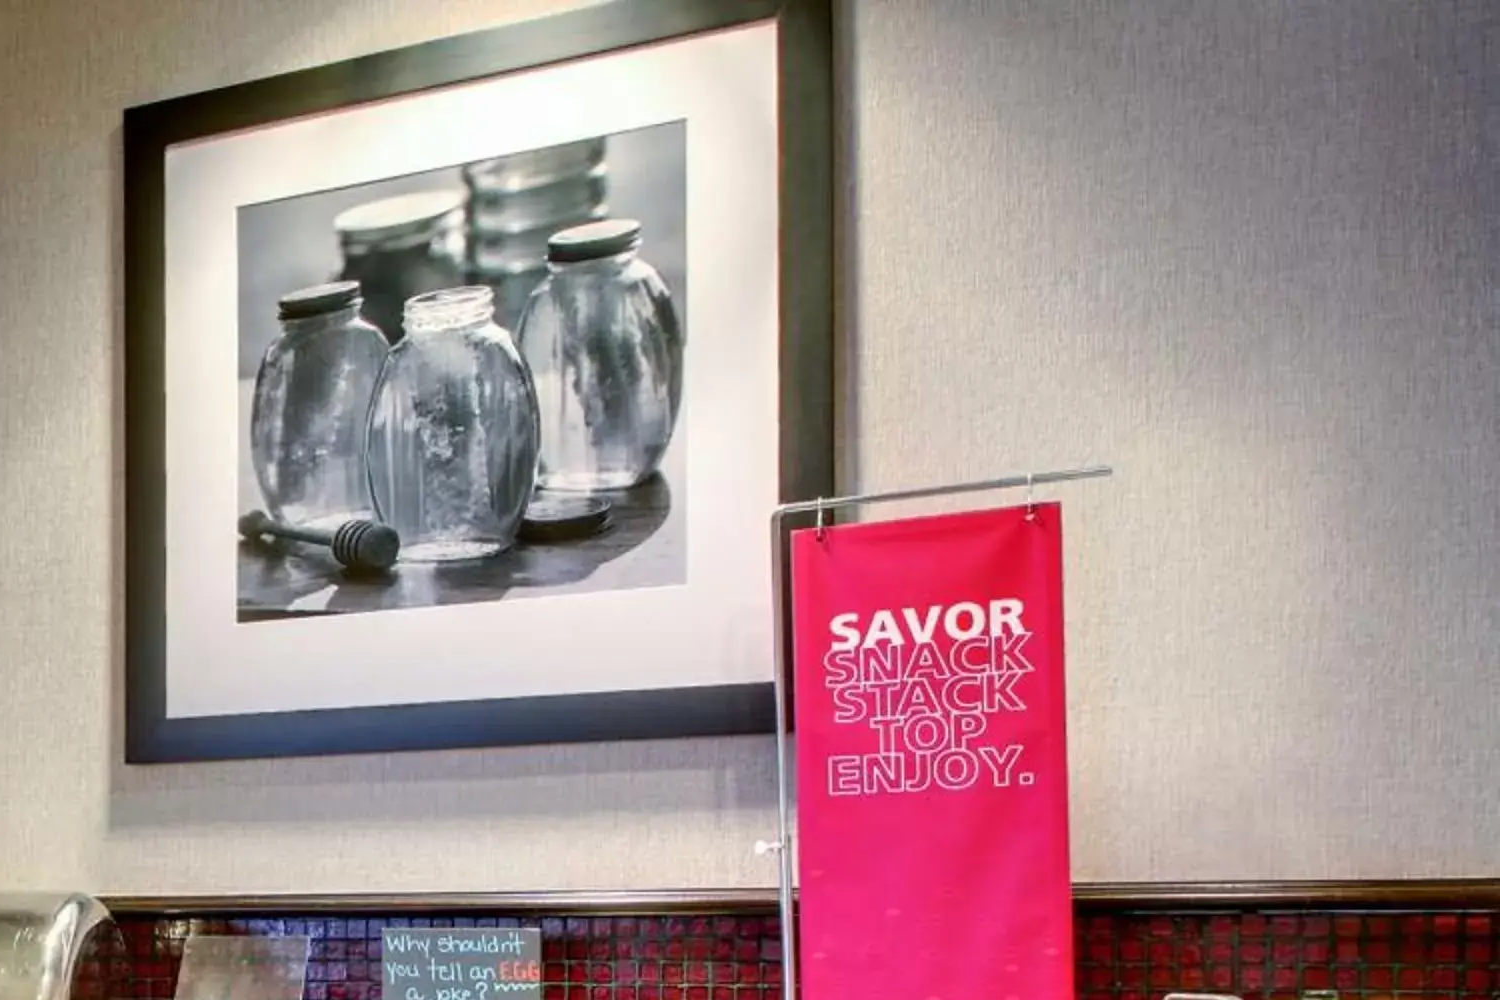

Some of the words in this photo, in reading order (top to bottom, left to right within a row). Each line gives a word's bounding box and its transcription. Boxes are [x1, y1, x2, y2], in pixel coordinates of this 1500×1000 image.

[828, 597, 1027, 652] SAVOR
[823, 631, 1036, 689] SNACK
[833, 670, 1028, 724] STACK
[869, 711, 988, 758] TOP
[827, 744, 1035, 796] ENJOY.
[385, 932, 430, 959] Why
[437, 931, 526, 955] shouldn't
[385, 960, 421, 985] you
[427, 957, 464, 983] tell
[469, 966, 496, 981] an
[499, 959, 541, 982] EGG
[405, 986, 425, 1000] a
